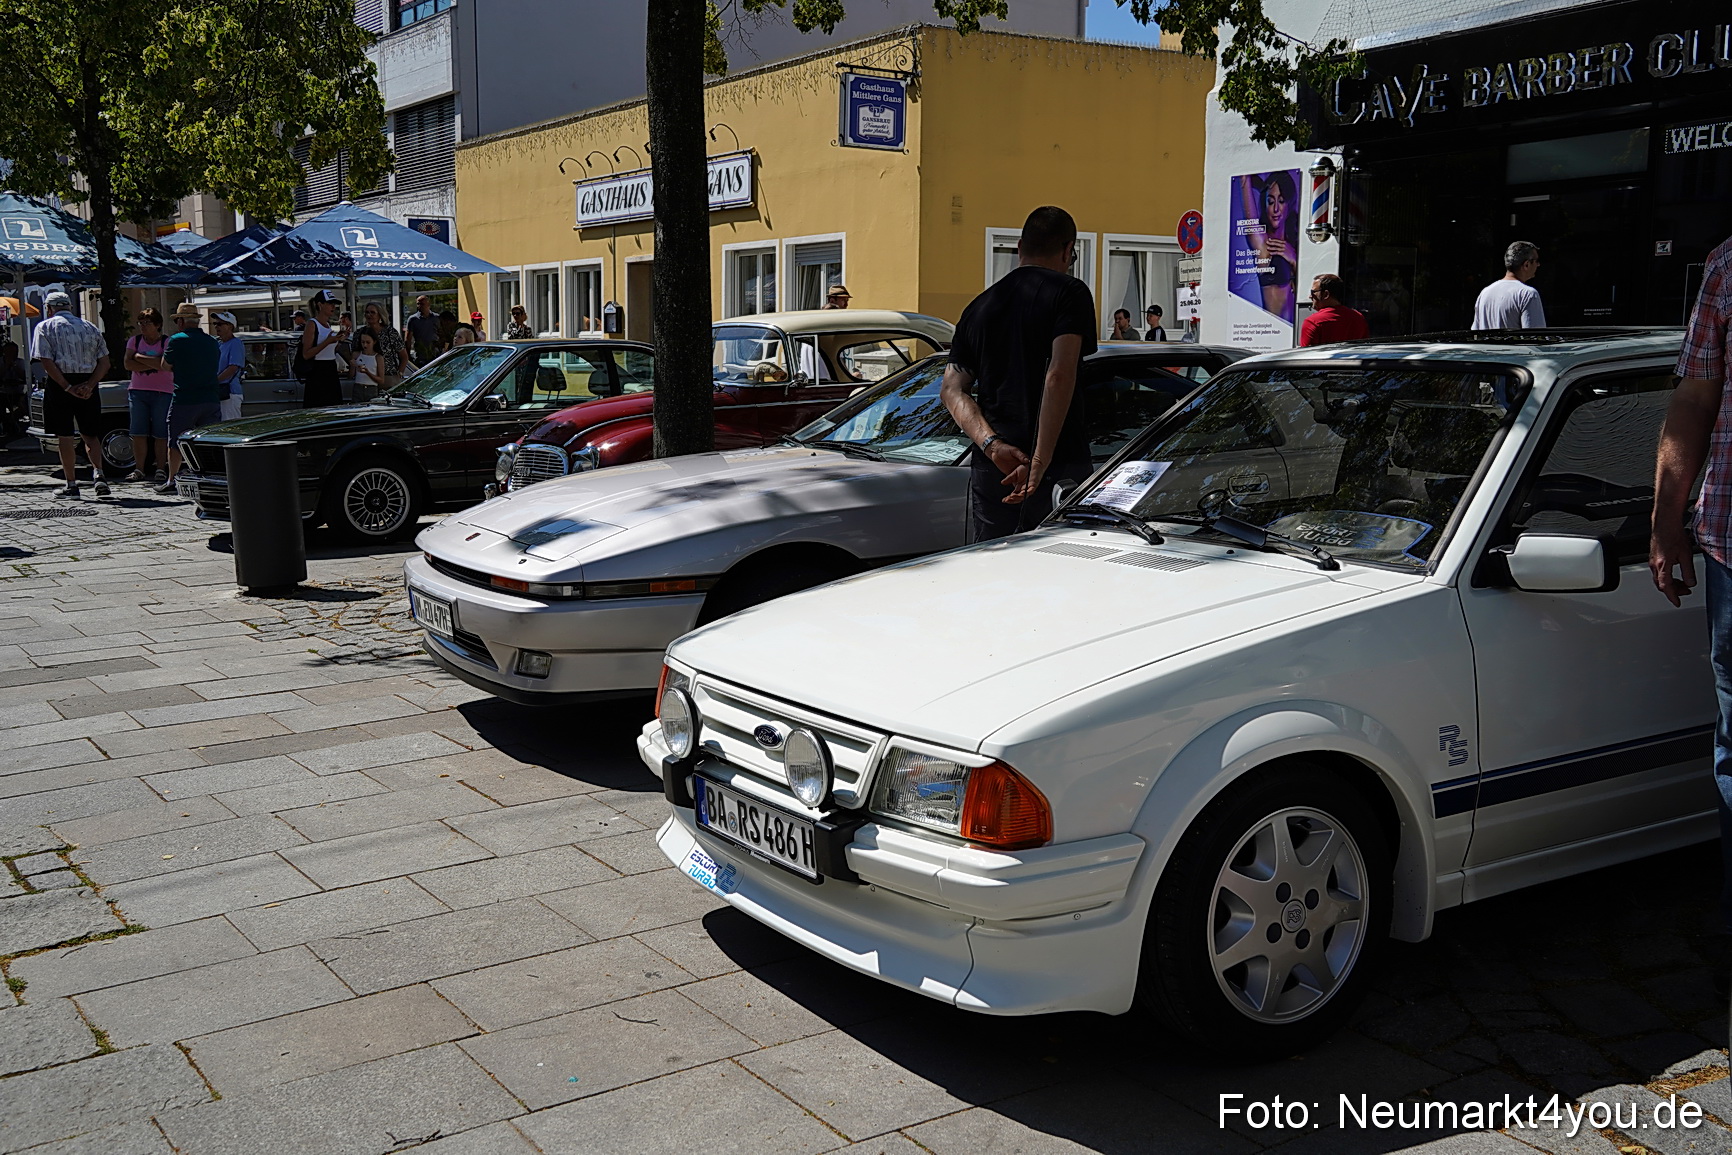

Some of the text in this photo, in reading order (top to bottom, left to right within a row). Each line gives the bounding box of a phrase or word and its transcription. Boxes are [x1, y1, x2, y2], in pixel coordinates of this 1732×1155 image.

[1463, 41, 1634, 107] BARBER
[852, 91, 902, 103] Mittlere Gans
[860, 82, 895, 93] Gasthaus
[580, 181, 648, 215] GASTHAUS
[299, 250, 427, 261] GANSBRÄU
[364, 261, 400, 269] guter
[400, 261, 458, 270] Schluck
[1235, 266, 1276, 275] Haarentfernung
[1296, 522, 1357, 538] ESCORT
[1438, 724, 1469, 767] RS
[705, 785, 729, 832] BA
[690, 849, 723, 875] ESCORT
[687, 863, 717, 889] TURBO
